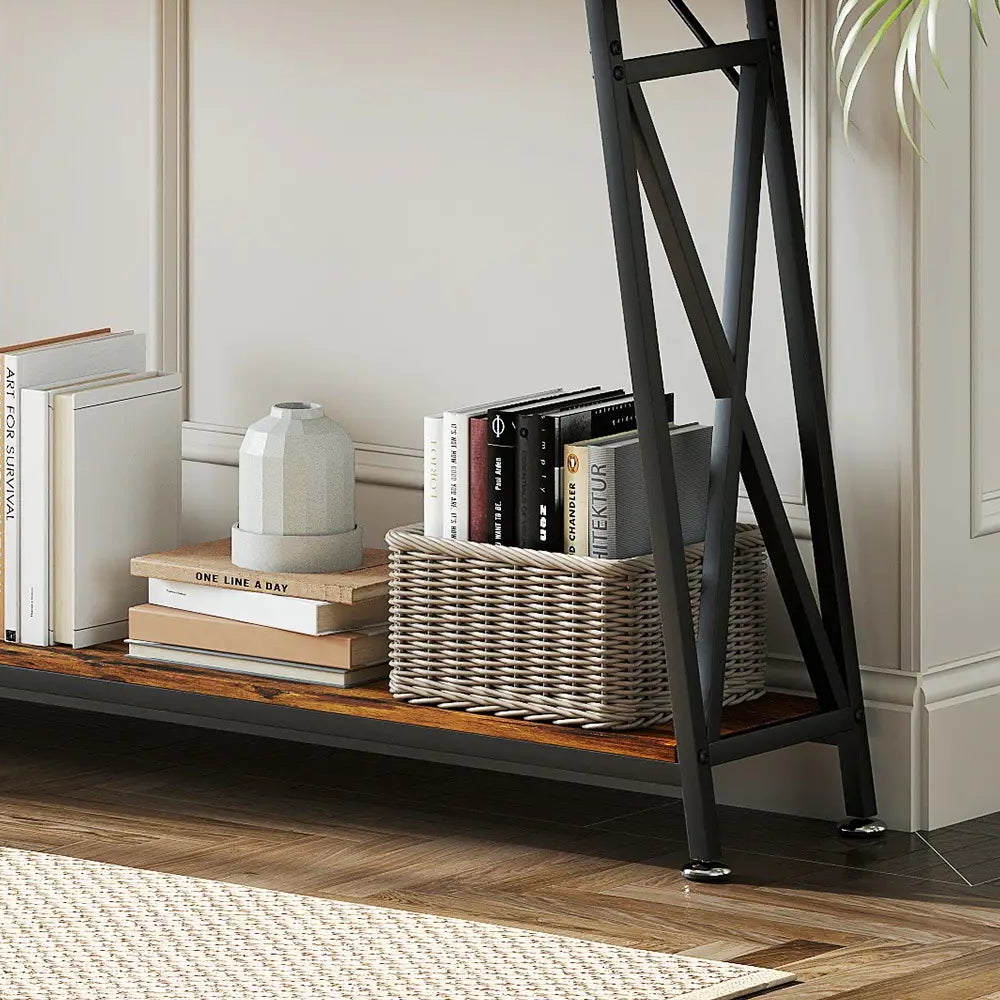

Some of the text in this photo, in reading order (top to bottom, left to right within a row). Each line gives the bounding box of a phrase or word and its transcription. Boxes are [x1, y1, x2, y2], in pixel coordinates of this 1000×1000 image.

[6, 366, 15, 520] ART FOR SURVIVAL
[494, 512, 502, 520] TO
[539, 504, 547, 542] zen
[568, 482, 576, 541] CHANDLER
[591, 463, 607, 559] HITEKTUR
[494, 521, 502, 540] WANT
[195, 571, 288, 593] ONE LINE A DAY
